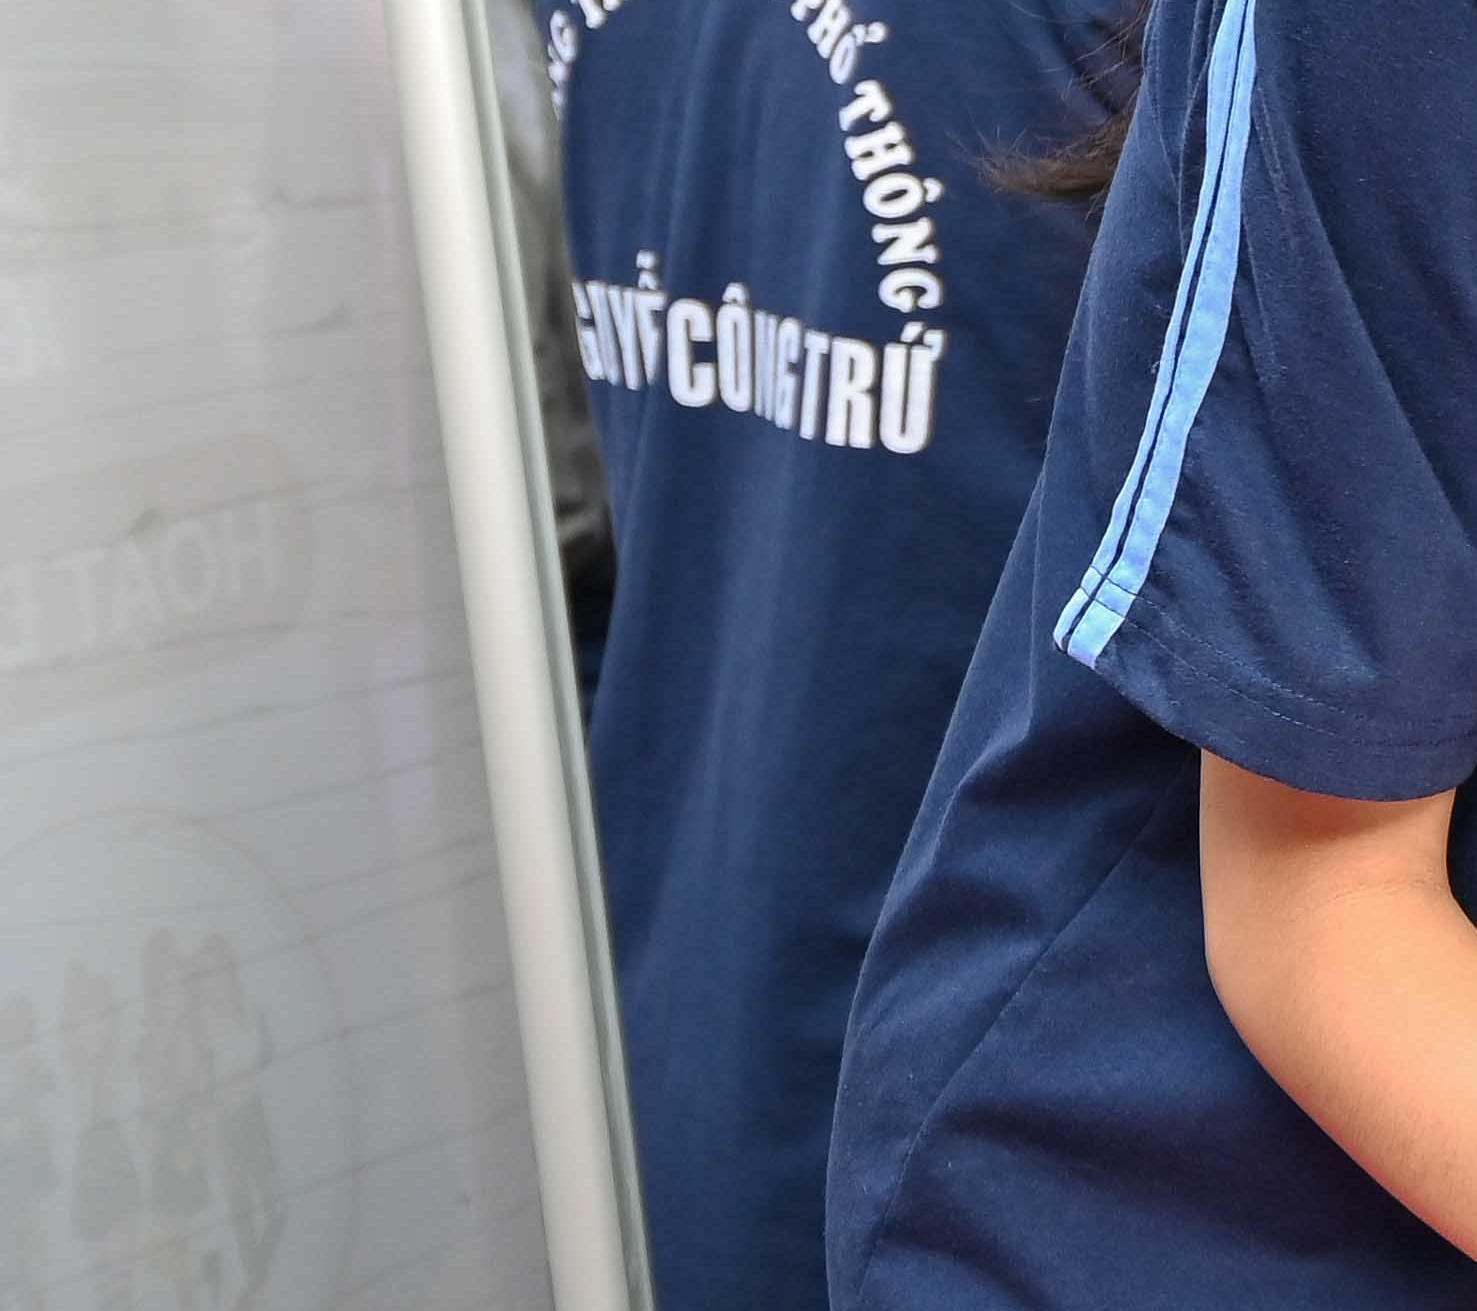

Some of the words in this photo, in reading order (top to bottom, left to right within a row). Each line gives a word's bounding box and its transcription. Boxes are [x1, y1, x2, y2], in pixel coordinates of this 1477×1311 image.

[838, 78, 946, 315] THÔNG
[664, 281, 801, 431] CÔNG
[799, 321, 947, 455] TRỨ
